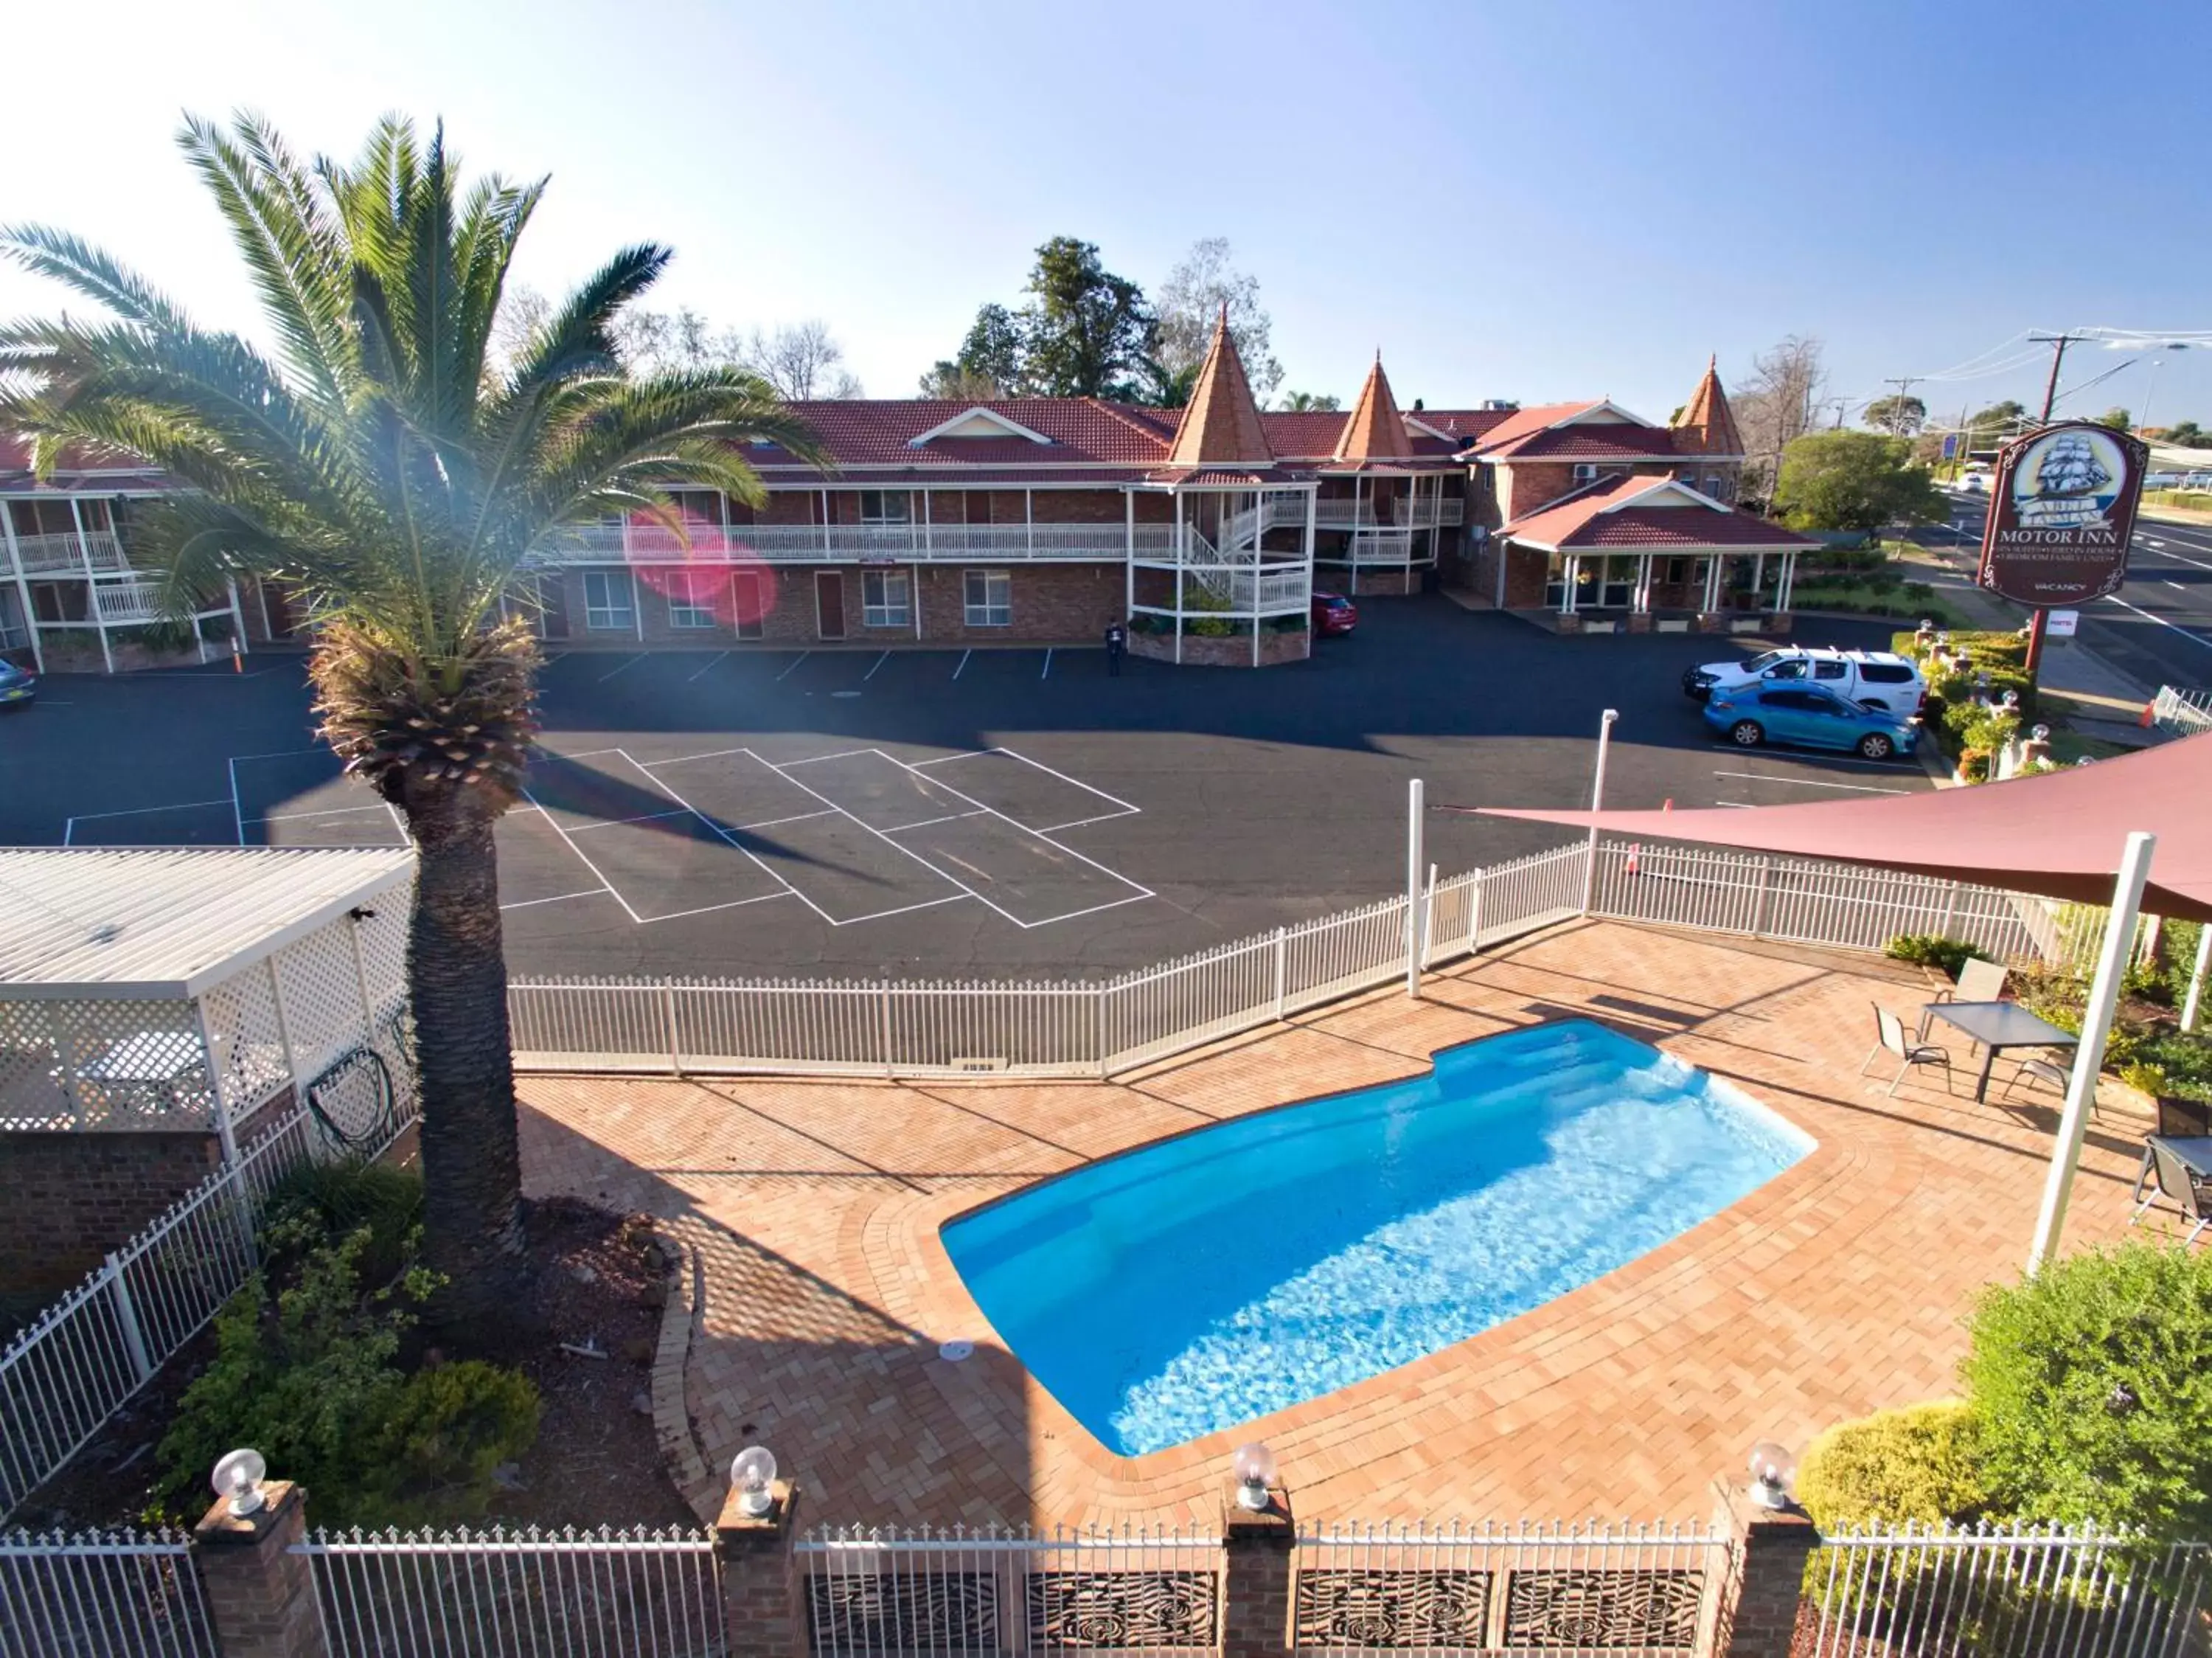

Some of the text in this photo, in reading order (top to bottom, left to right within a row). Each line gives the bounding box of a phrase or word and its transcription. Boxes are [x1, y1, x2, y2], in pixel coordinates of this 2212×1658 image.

[2039, 500, 2087, 512] ABEL
[2030, 510, 2099, 526] TASMAN
[2000, 530, 2119, 544] MOTOR INN
[2035, 583, 2087, 591] VACANCY
